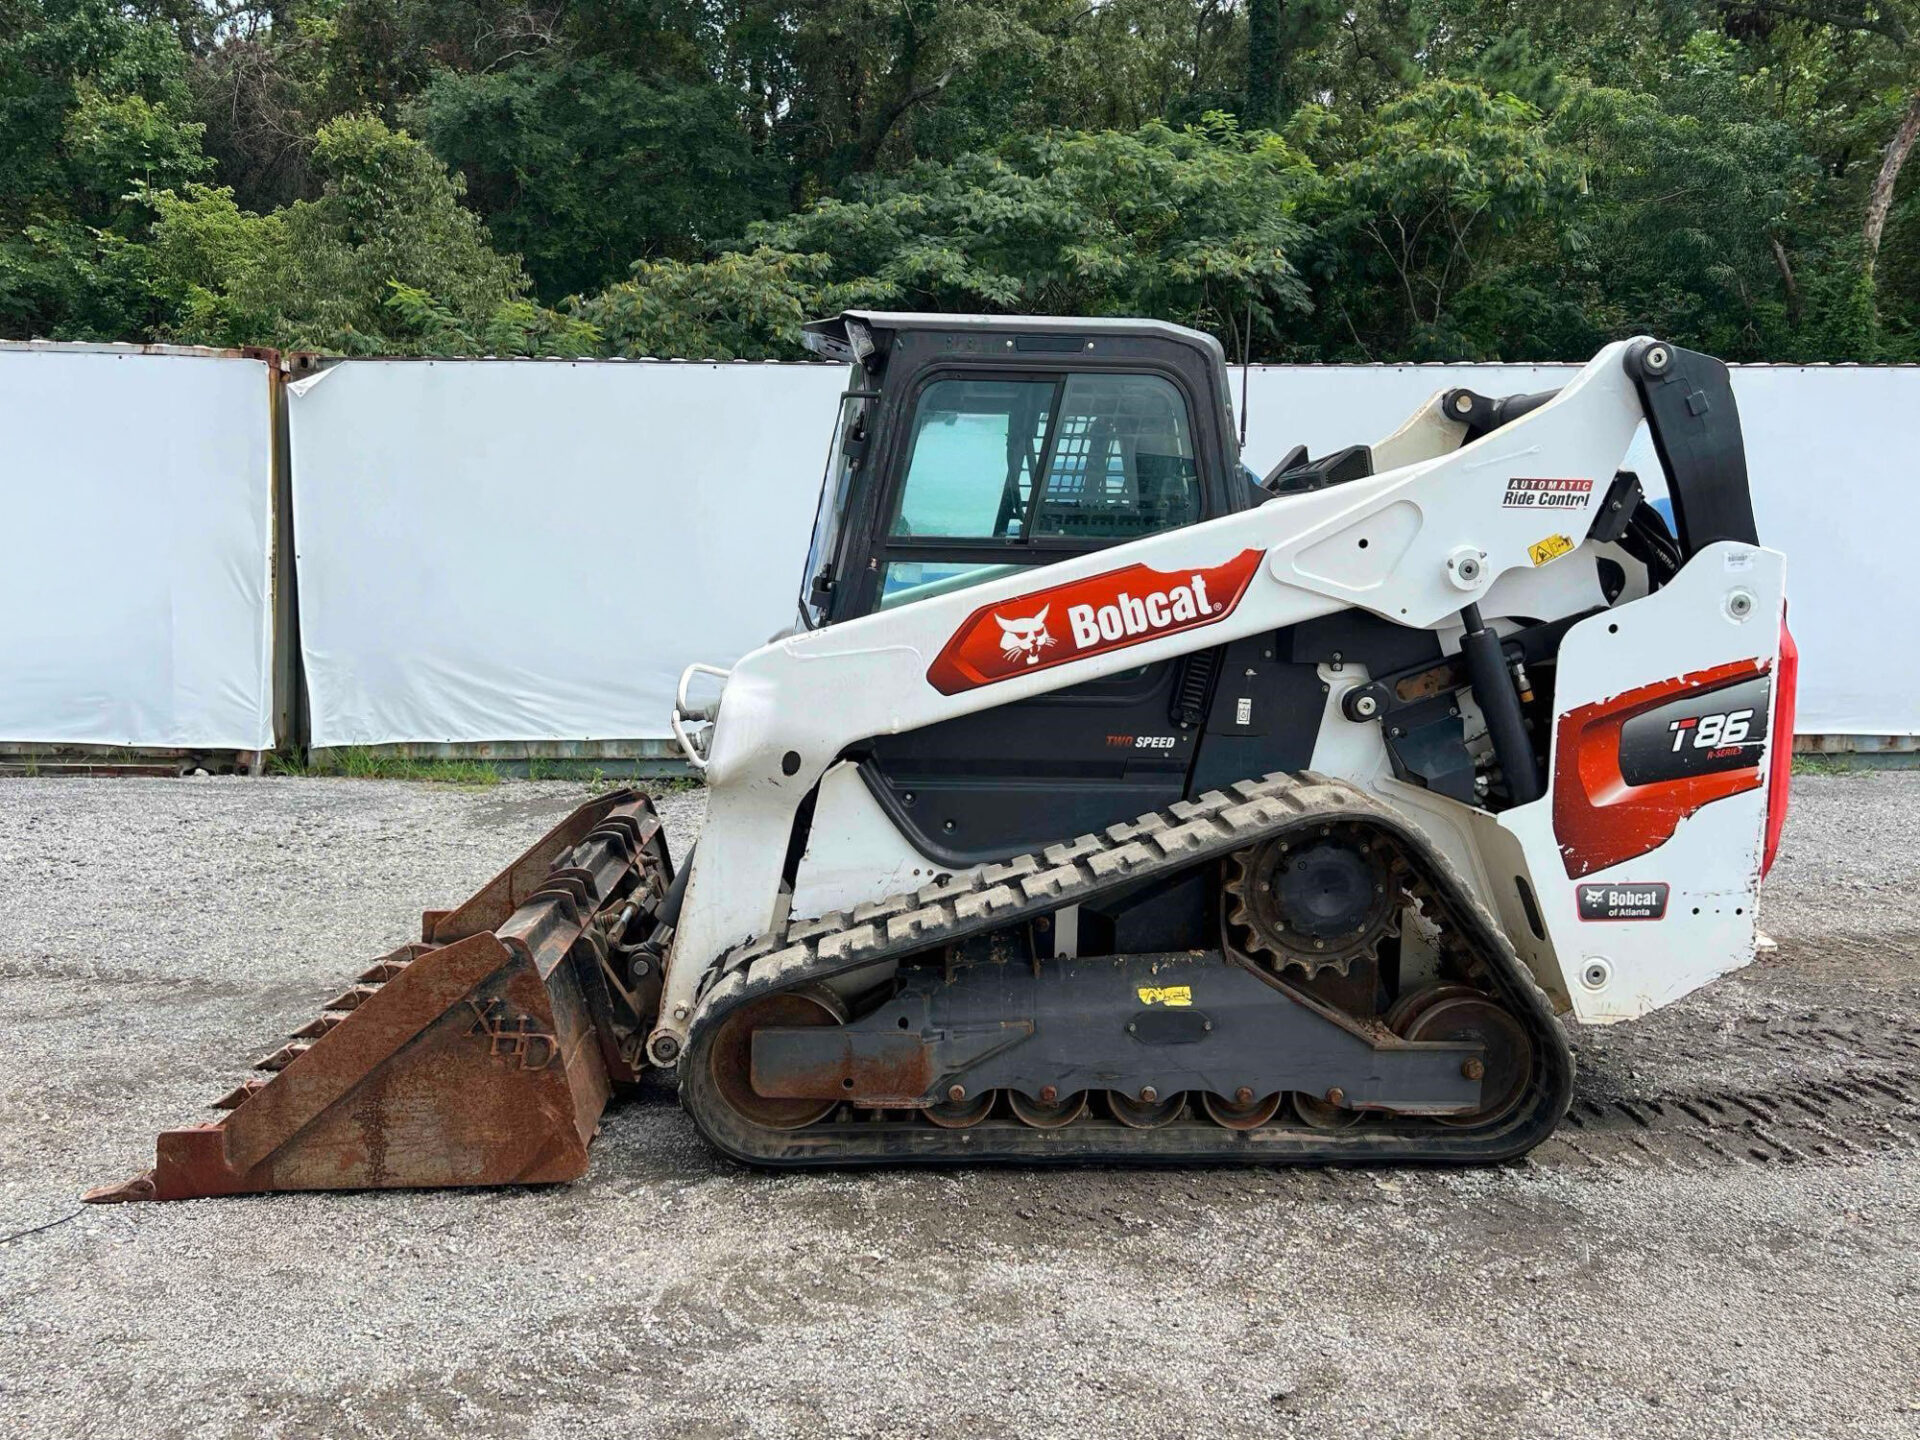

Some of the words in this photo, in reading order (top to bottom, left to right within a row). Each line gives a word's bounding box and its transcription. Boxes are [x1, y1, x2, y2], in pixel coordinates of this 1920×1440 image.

[1510, 480, 1591, 491] AUTOMATIC
[1502, 491, 1535, 505] Ride
[1067, 575, 1212, 649] Bobcat
[1669, 709, 1754, 752] T86
[1105, 734, 1134, 746] TWO
[1135, 736, 1176, 748] SPEED
[1608, 890, 1657, 906] Bobcat
[1608, 908, 1618, 917] of
[1619, 908, 1651, 917] Atlanta
[464, 996, 559, 1072] XHD
